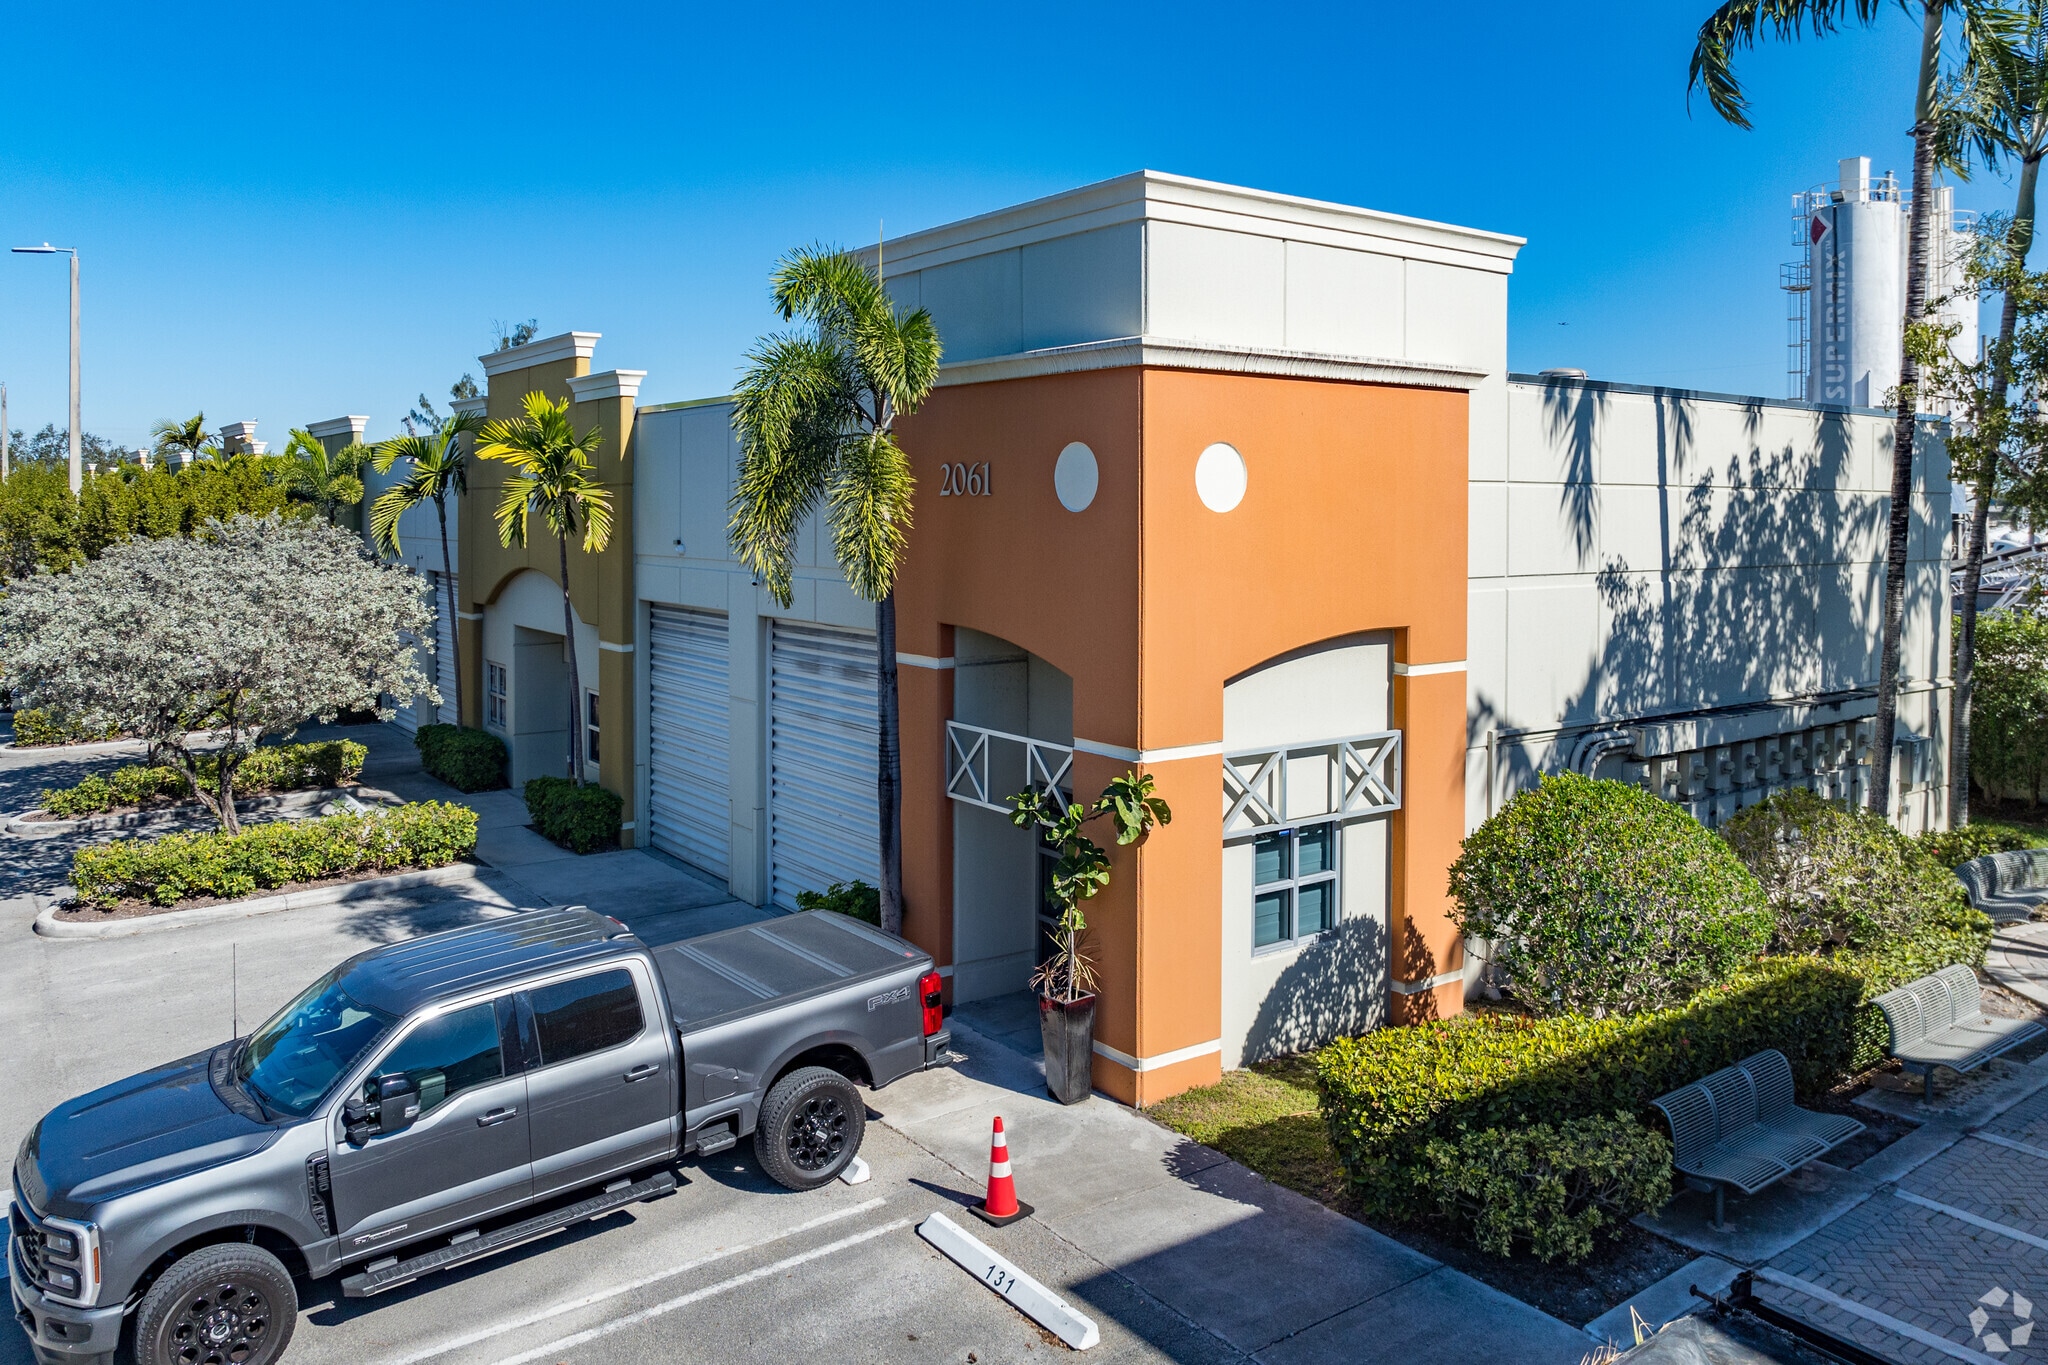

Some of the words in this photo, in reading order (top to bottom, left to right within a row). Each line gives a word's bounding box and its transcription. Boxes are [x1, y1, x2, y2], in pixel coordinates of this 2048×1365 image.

[1825, 250, 1846, 399] SUPERMIX
[940, 461, 992, 497] 2061
[867, 985, 911, 1012] FX4
[985, 1264, 1016, 1294] 131
